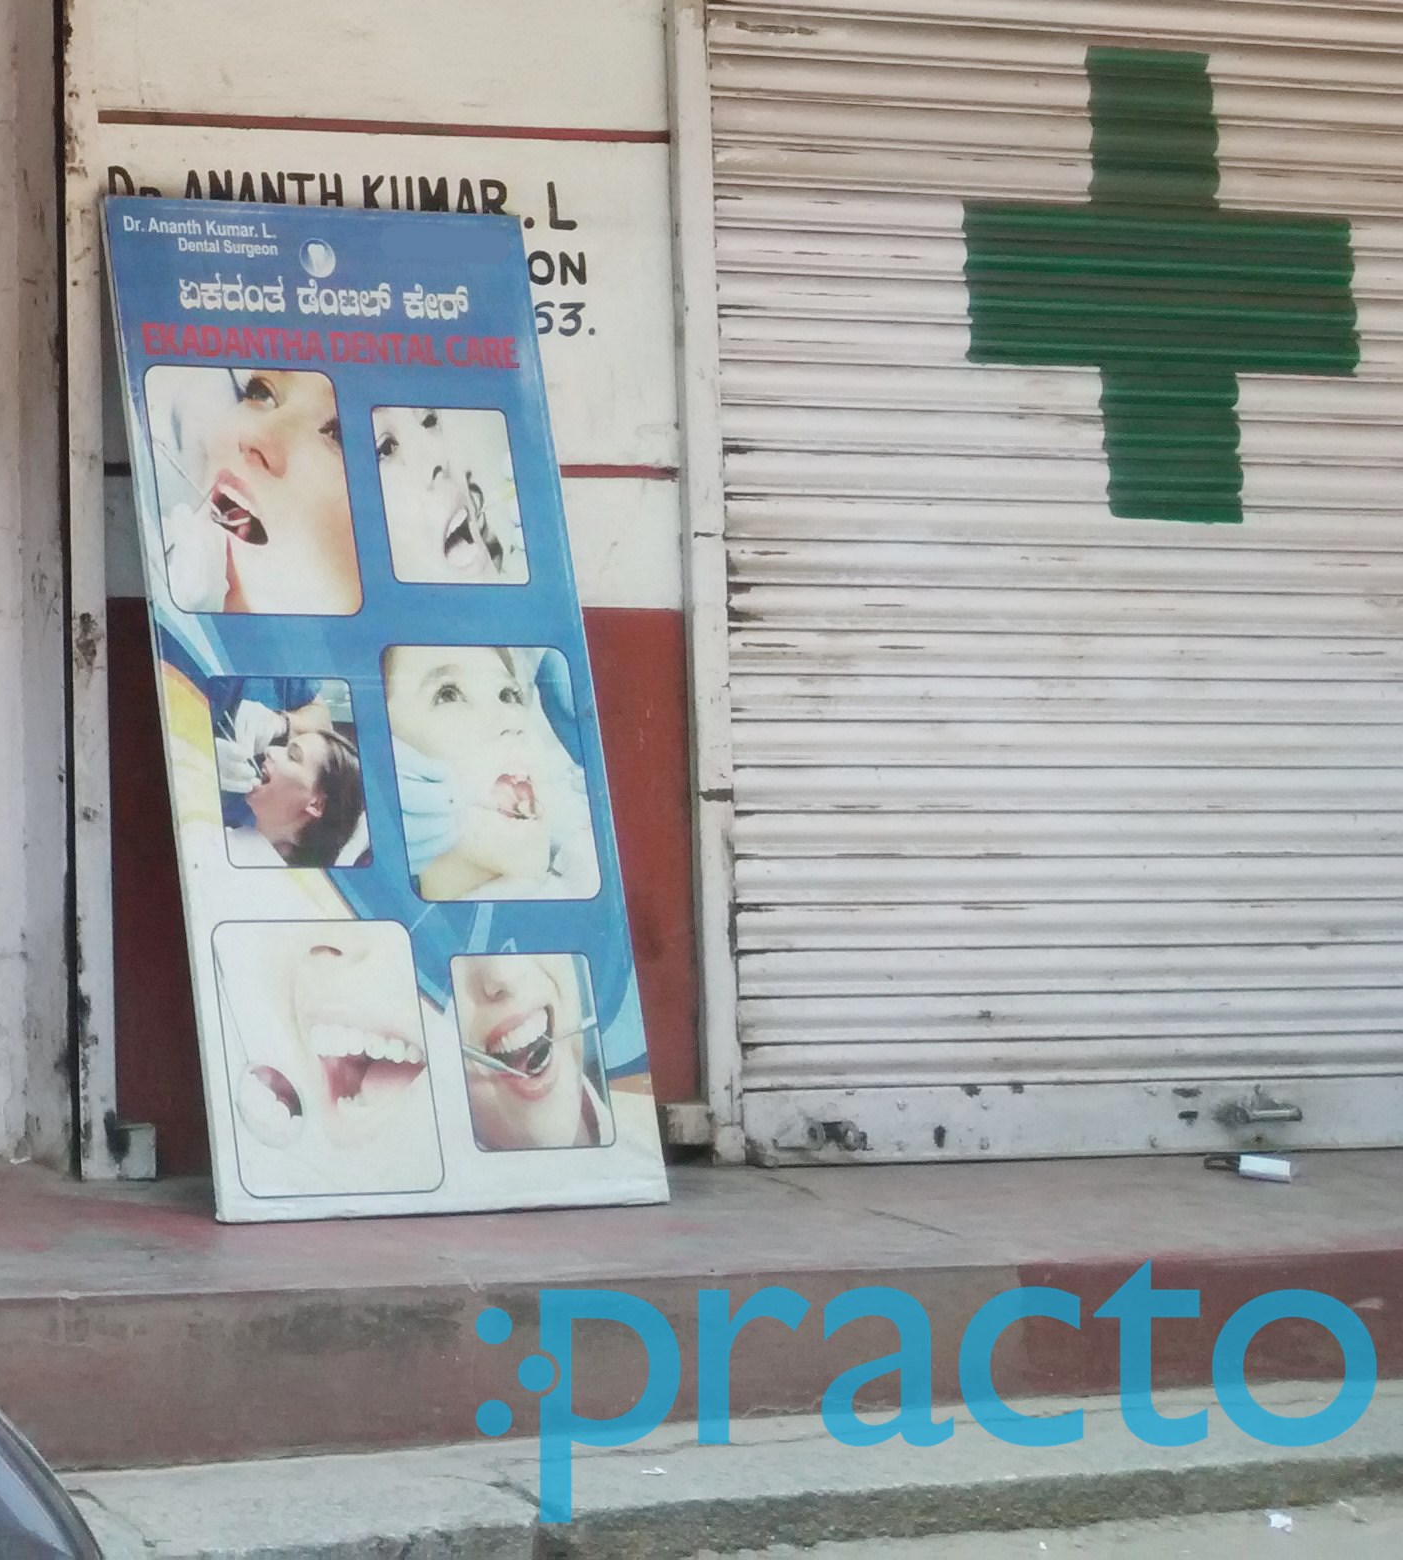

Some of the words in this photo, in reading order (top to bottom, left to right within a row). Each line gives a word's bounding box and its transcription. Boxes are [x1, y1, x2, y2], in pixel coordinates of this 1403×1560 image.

[123, 216, 144, 232] Dr.
[148, 217, 201, 235] Ananth
[206, 220, 258, 238] Kumar.
[178, 237, 220, 253] Dental
[224, 240, 278, 258] Surgeon
[141, 323, 325, 361] EKADANTHA
[329, 328, 441, 366] DENTAL
[446, 335, 519, 368] CARE
